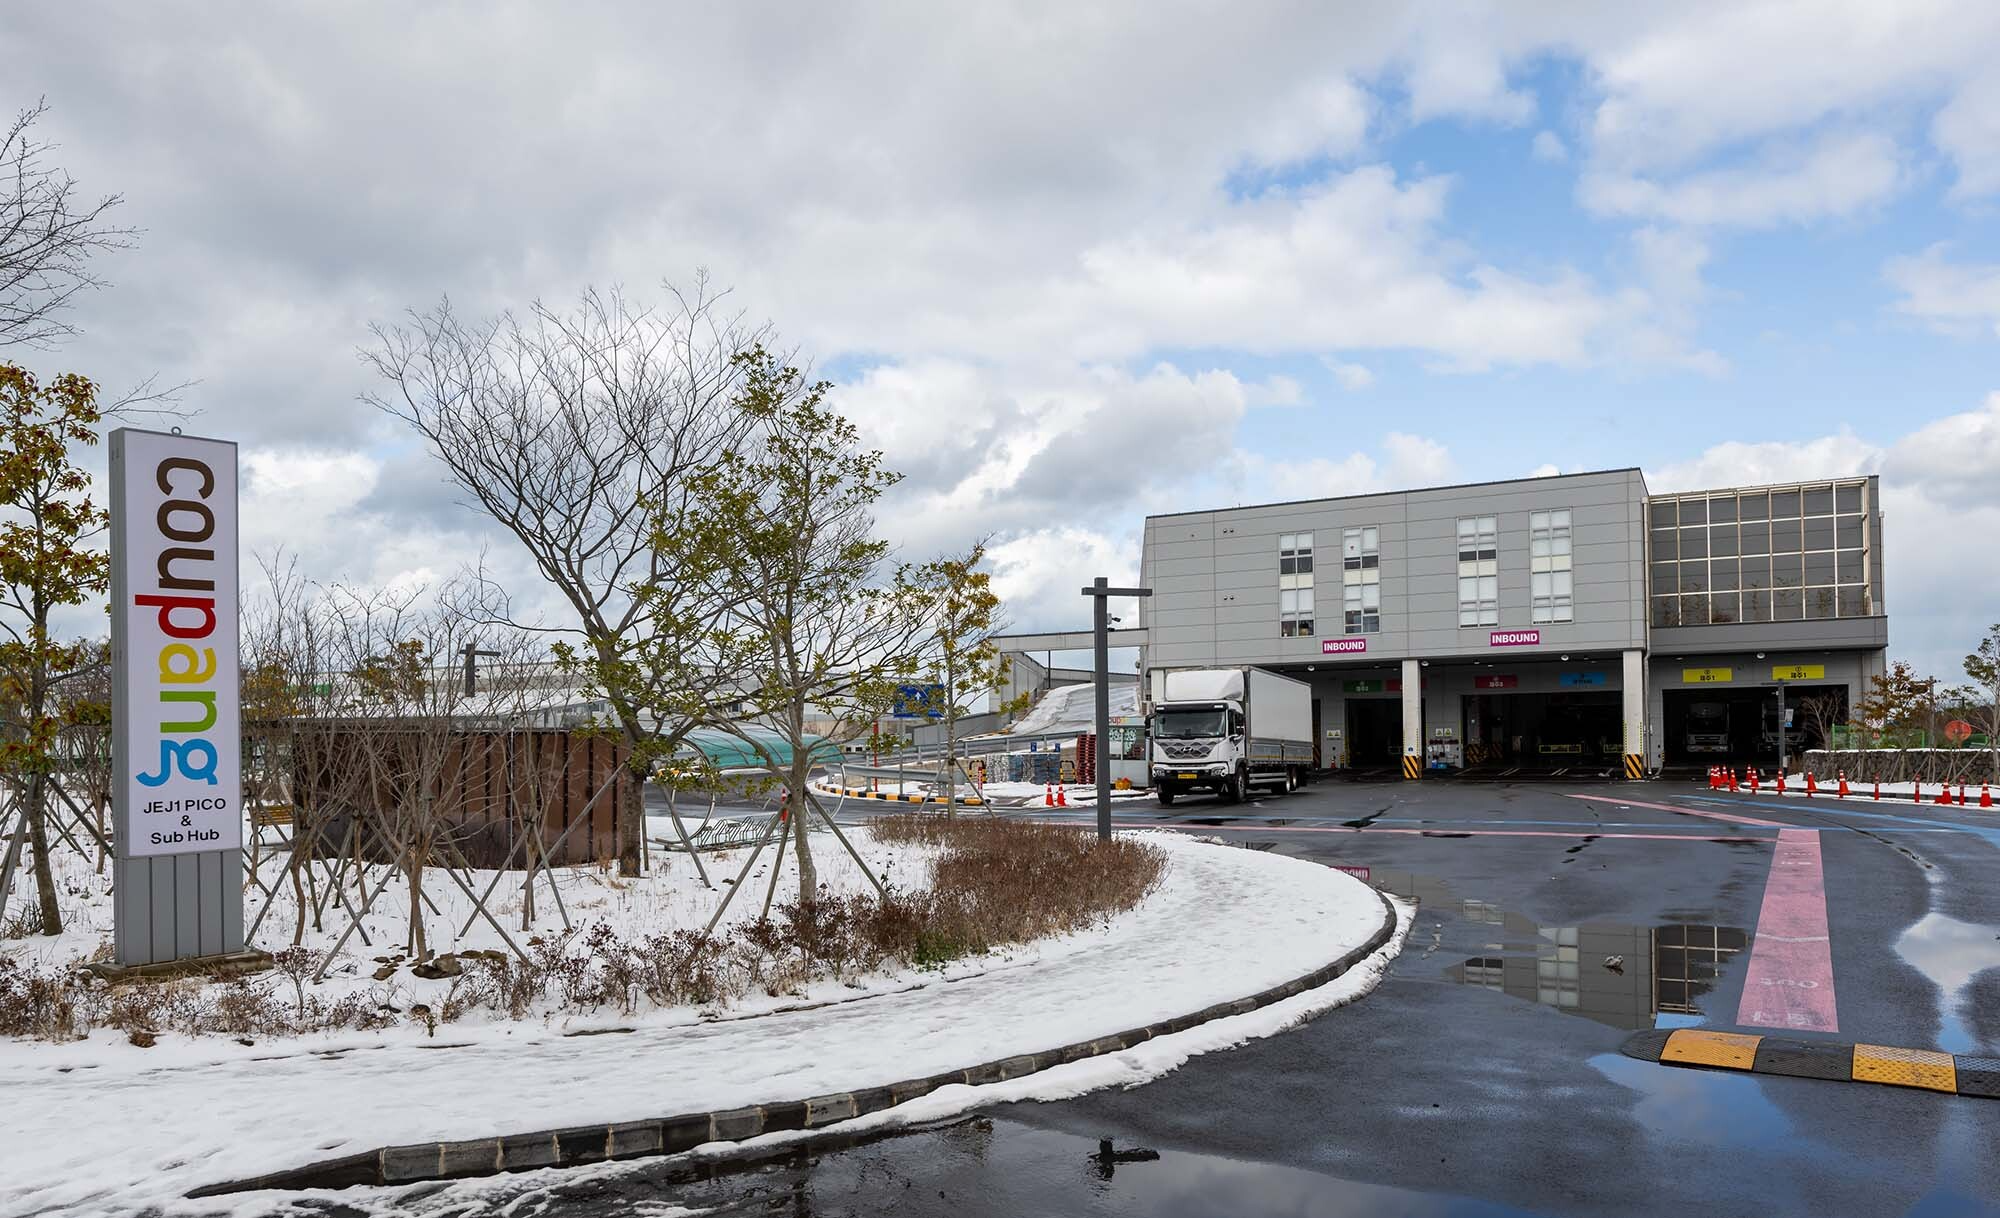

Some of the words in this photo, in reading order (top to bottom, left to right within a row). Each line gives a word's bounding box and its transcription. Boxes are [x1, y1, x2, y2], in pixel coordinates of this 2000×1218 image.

[134, 457, 218, 787] coupang
[1491, 633, 1538, 644] INBOUND
[1323, 641, 1365, 652] INBOUND
[143, 800, 180, 814] JEJ1
[184, 798, 226, 811] PICO
[180, 814, 192, 827] &
[150, 831, 184, 845] Sub
[187, 829, 220, 842] Hub
